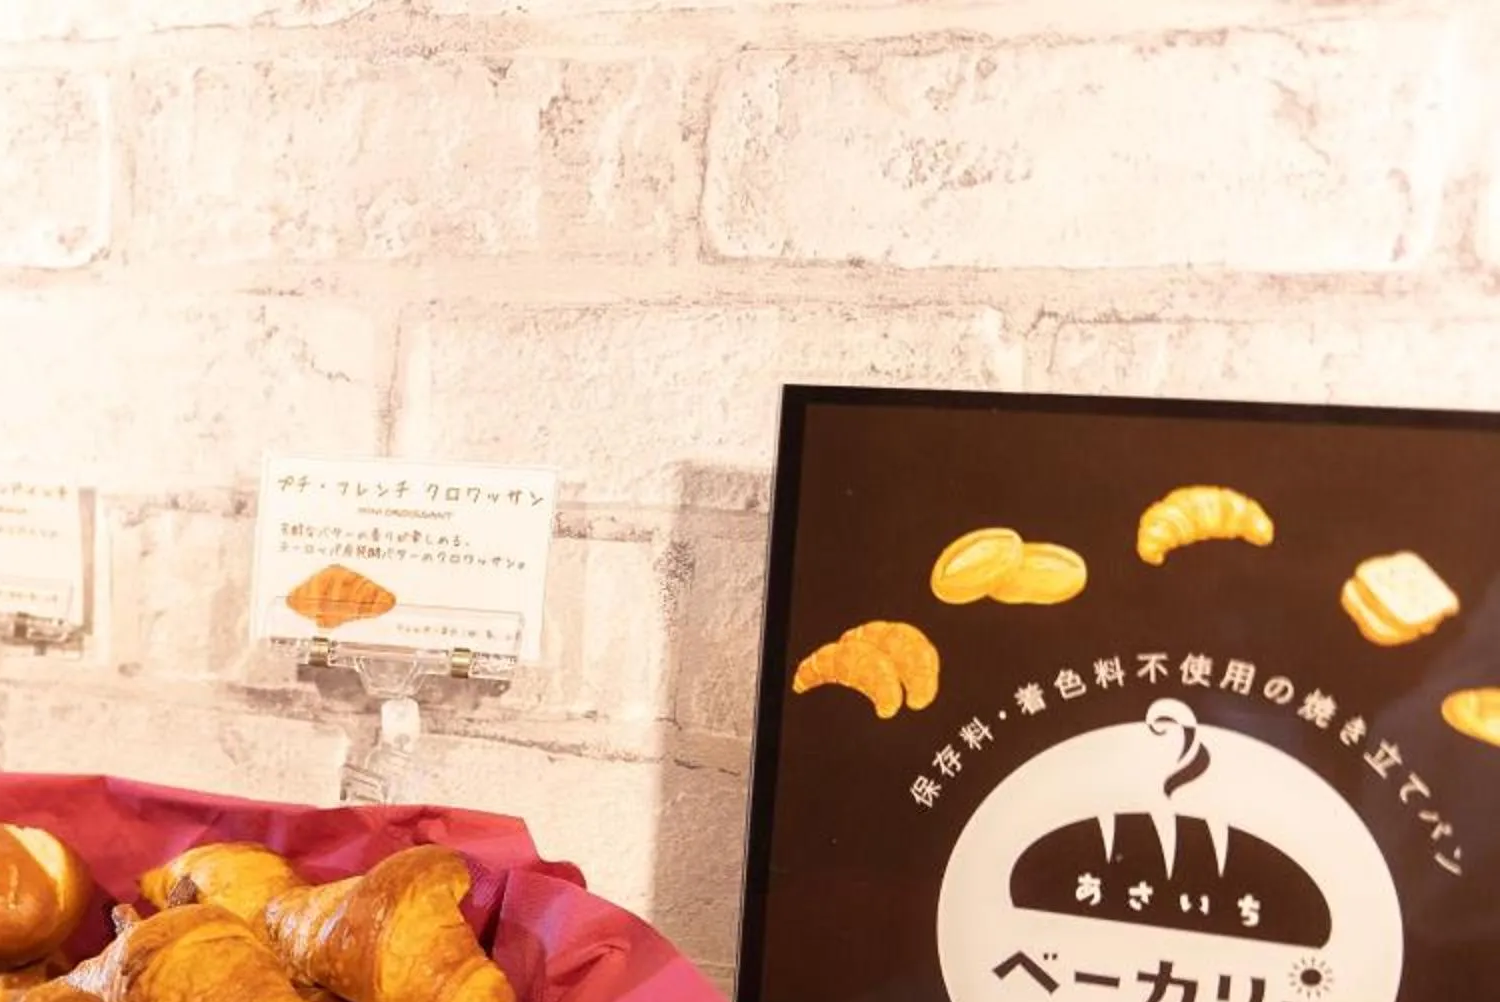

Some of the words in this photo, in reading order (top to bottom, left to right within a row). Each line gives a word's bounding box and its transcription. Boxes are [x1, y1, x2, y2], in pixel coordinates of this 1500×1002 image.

[425, 483, 545, 507] クロワッサン
[910, 652, 1463, 876] 保存料・着色料不使用の焼き立てパン
[1074, 872, 1262, 928] あさいち
